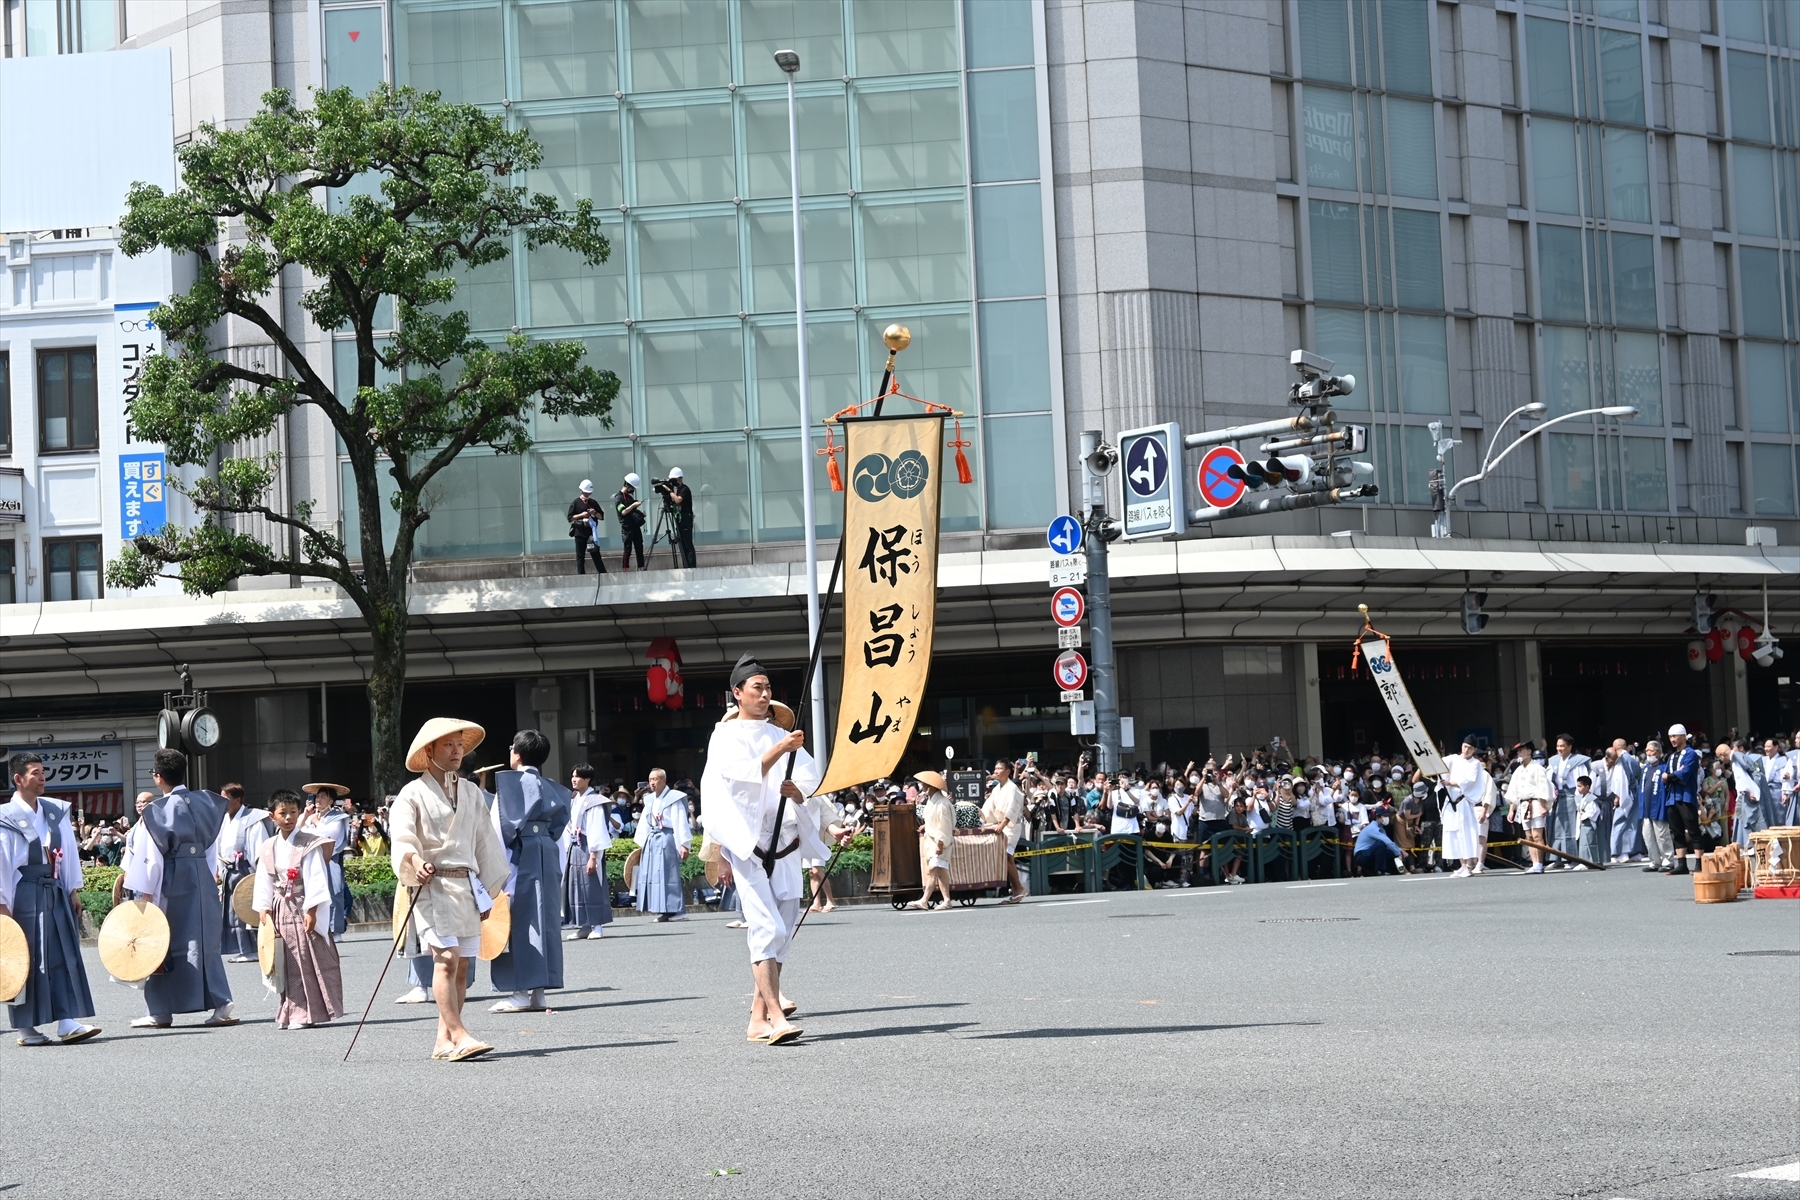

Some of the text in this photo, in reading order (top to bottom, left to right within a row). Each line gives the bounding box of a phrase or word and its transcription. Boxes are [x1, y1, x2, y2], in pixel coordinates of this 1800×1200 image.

[123, 461, 141, 537] 買えます
[143, 463, 160, 500] すぐ
[910, 529, 923, 574] ほう
[848, 524, 912, 744] 保昌山
[908, 604, 920, 663] しょう
[891, 696, 911, 733] やま
[43, 763, 109, 782] ンタクト
[51, 751, 108, 761] メガネスーパー
